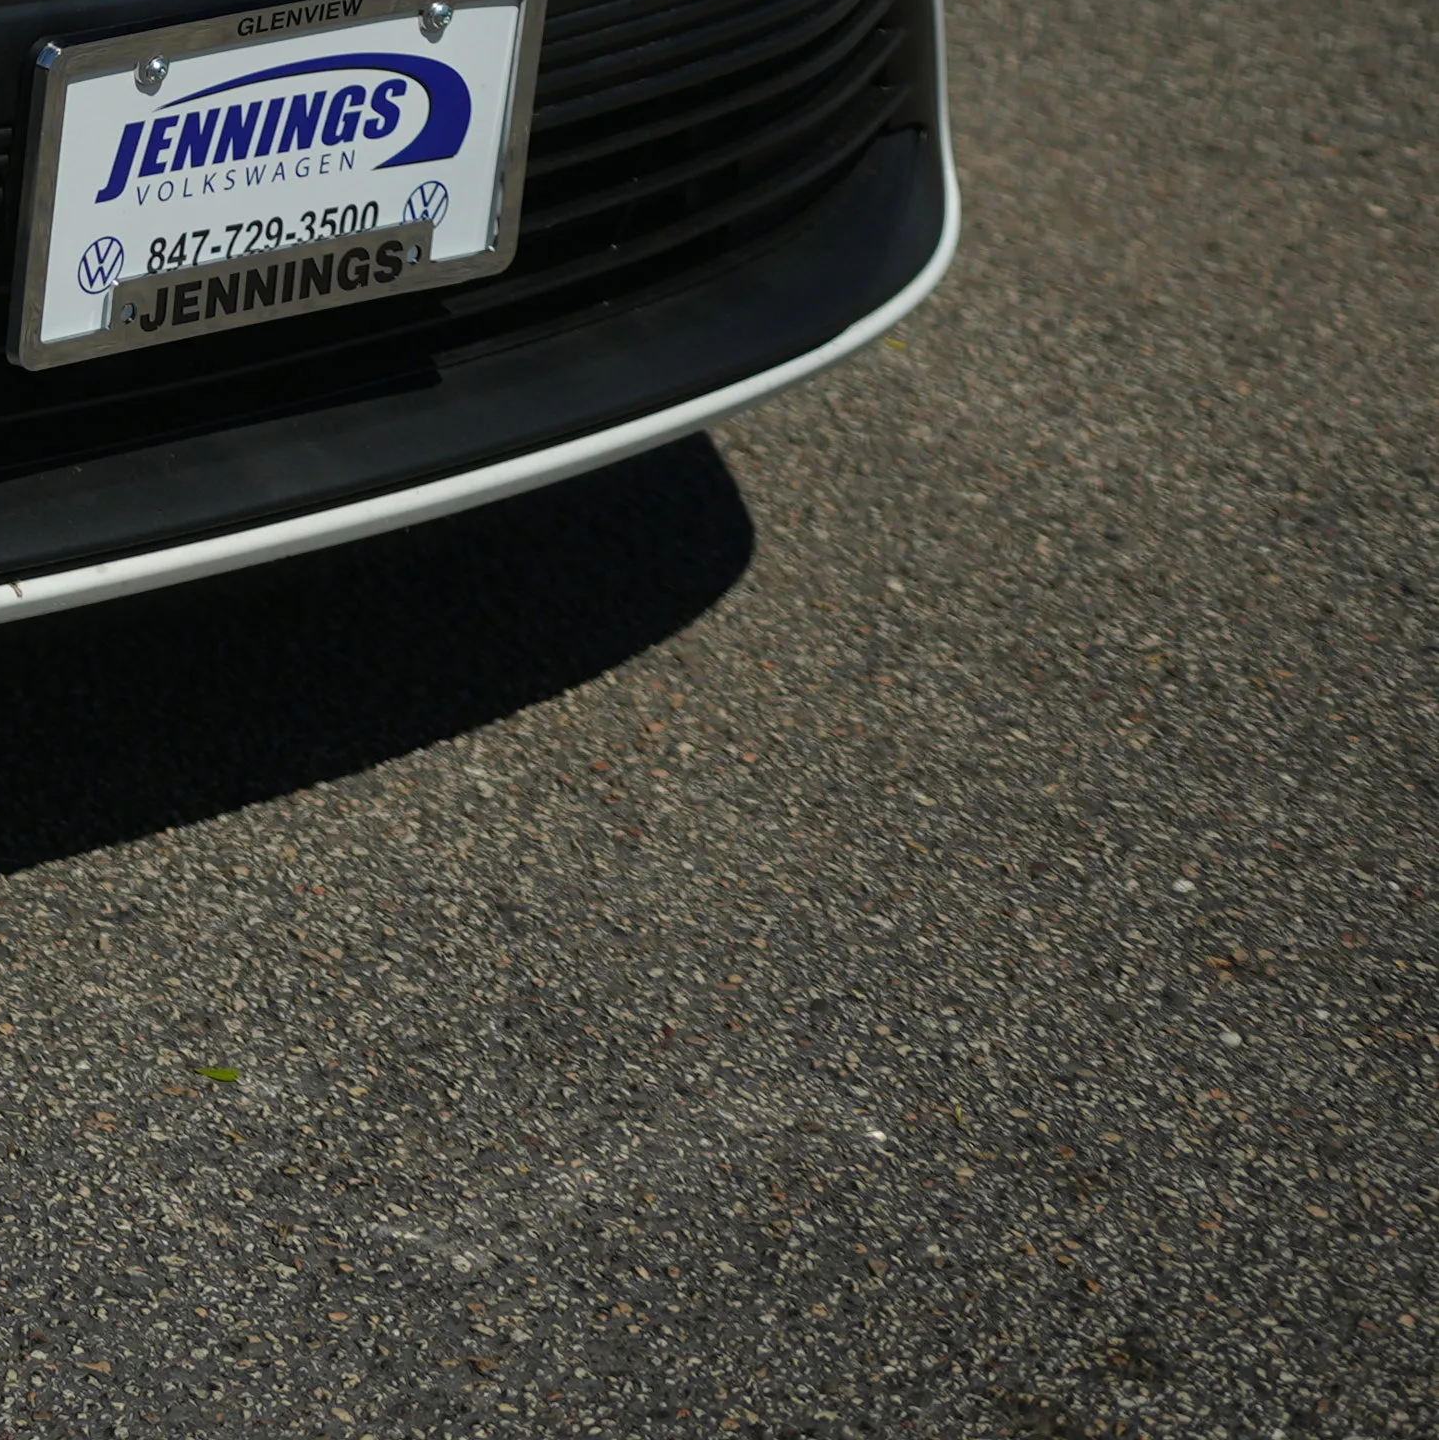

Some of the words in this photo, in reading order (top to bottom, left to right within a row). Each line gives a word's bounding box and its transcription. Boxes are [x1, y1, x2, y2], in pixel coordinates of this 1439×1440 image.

[95, 78, 408, 204] JENNINGS
[137, 150, 356, 206] VOLKSWAGEN
[146, 200, 380, 275] 847-729-3500
[140, 239, 405, 333] JENNINGS
